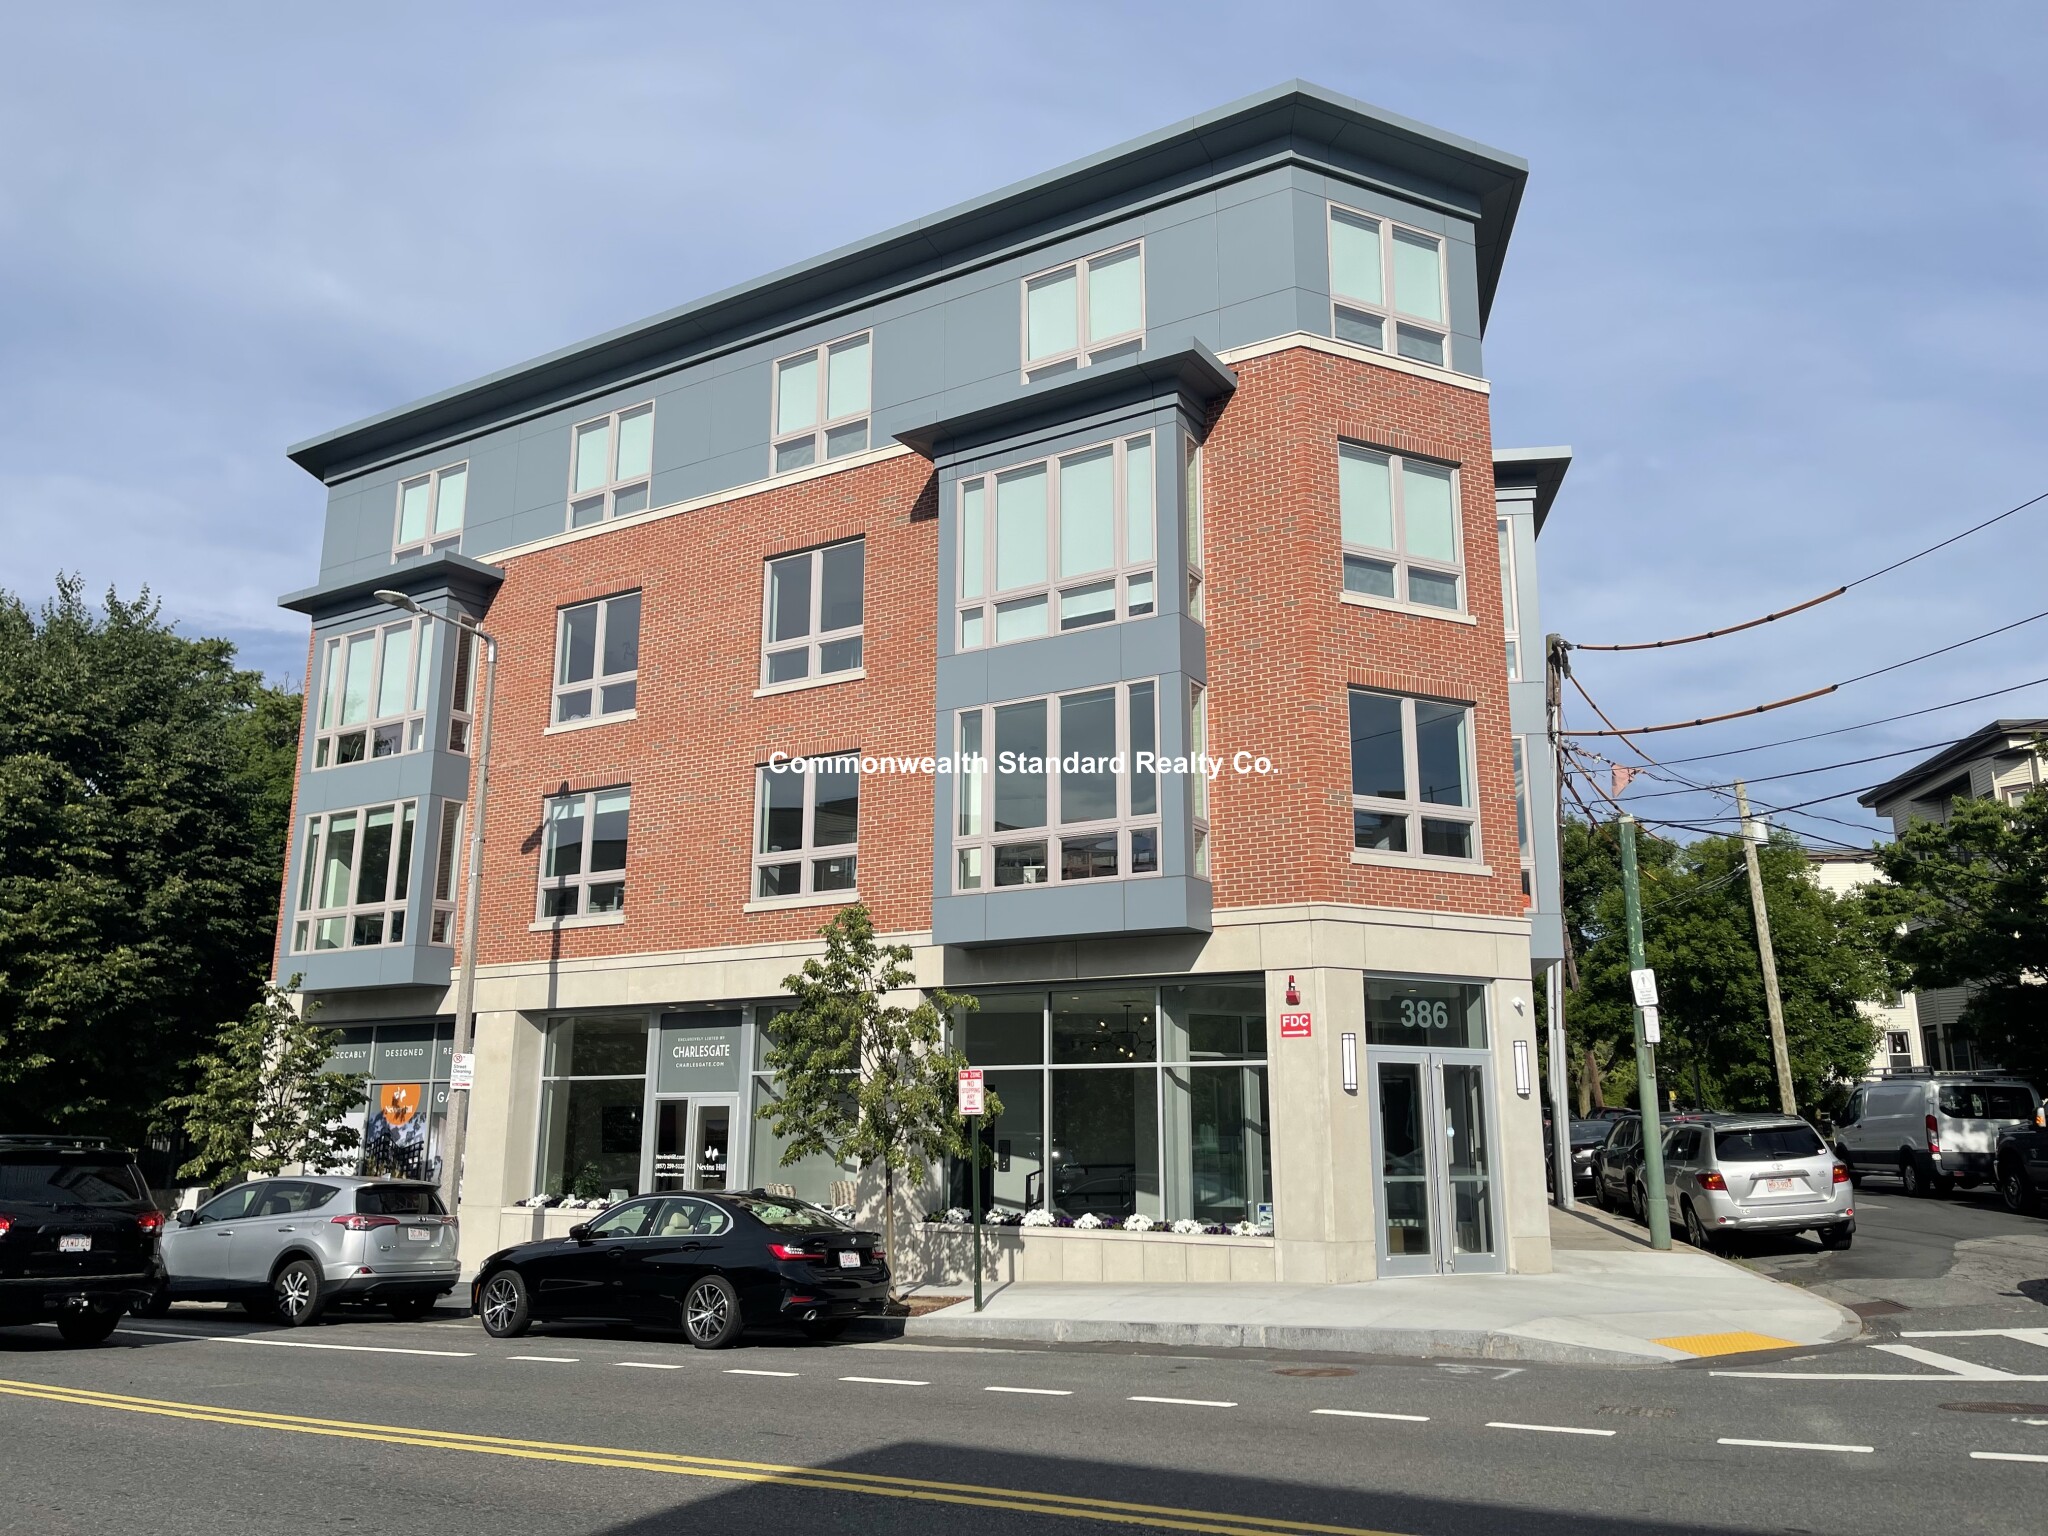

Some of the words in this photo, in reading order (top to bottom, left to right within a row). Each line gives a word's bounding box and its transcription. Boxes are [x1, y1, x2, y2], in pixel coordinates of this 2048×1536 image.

[1400, 999, 1448, 1029] 386
[1282, 1015, 1309, 1027] FDC
[385, 1048, 424, 1057] DESIGNED
[672, 1044, 730, 1058] CHARLESGATE
[696, 1163, 715, 1171] Nevins
[715, 1163, 726, 1171] Hill
